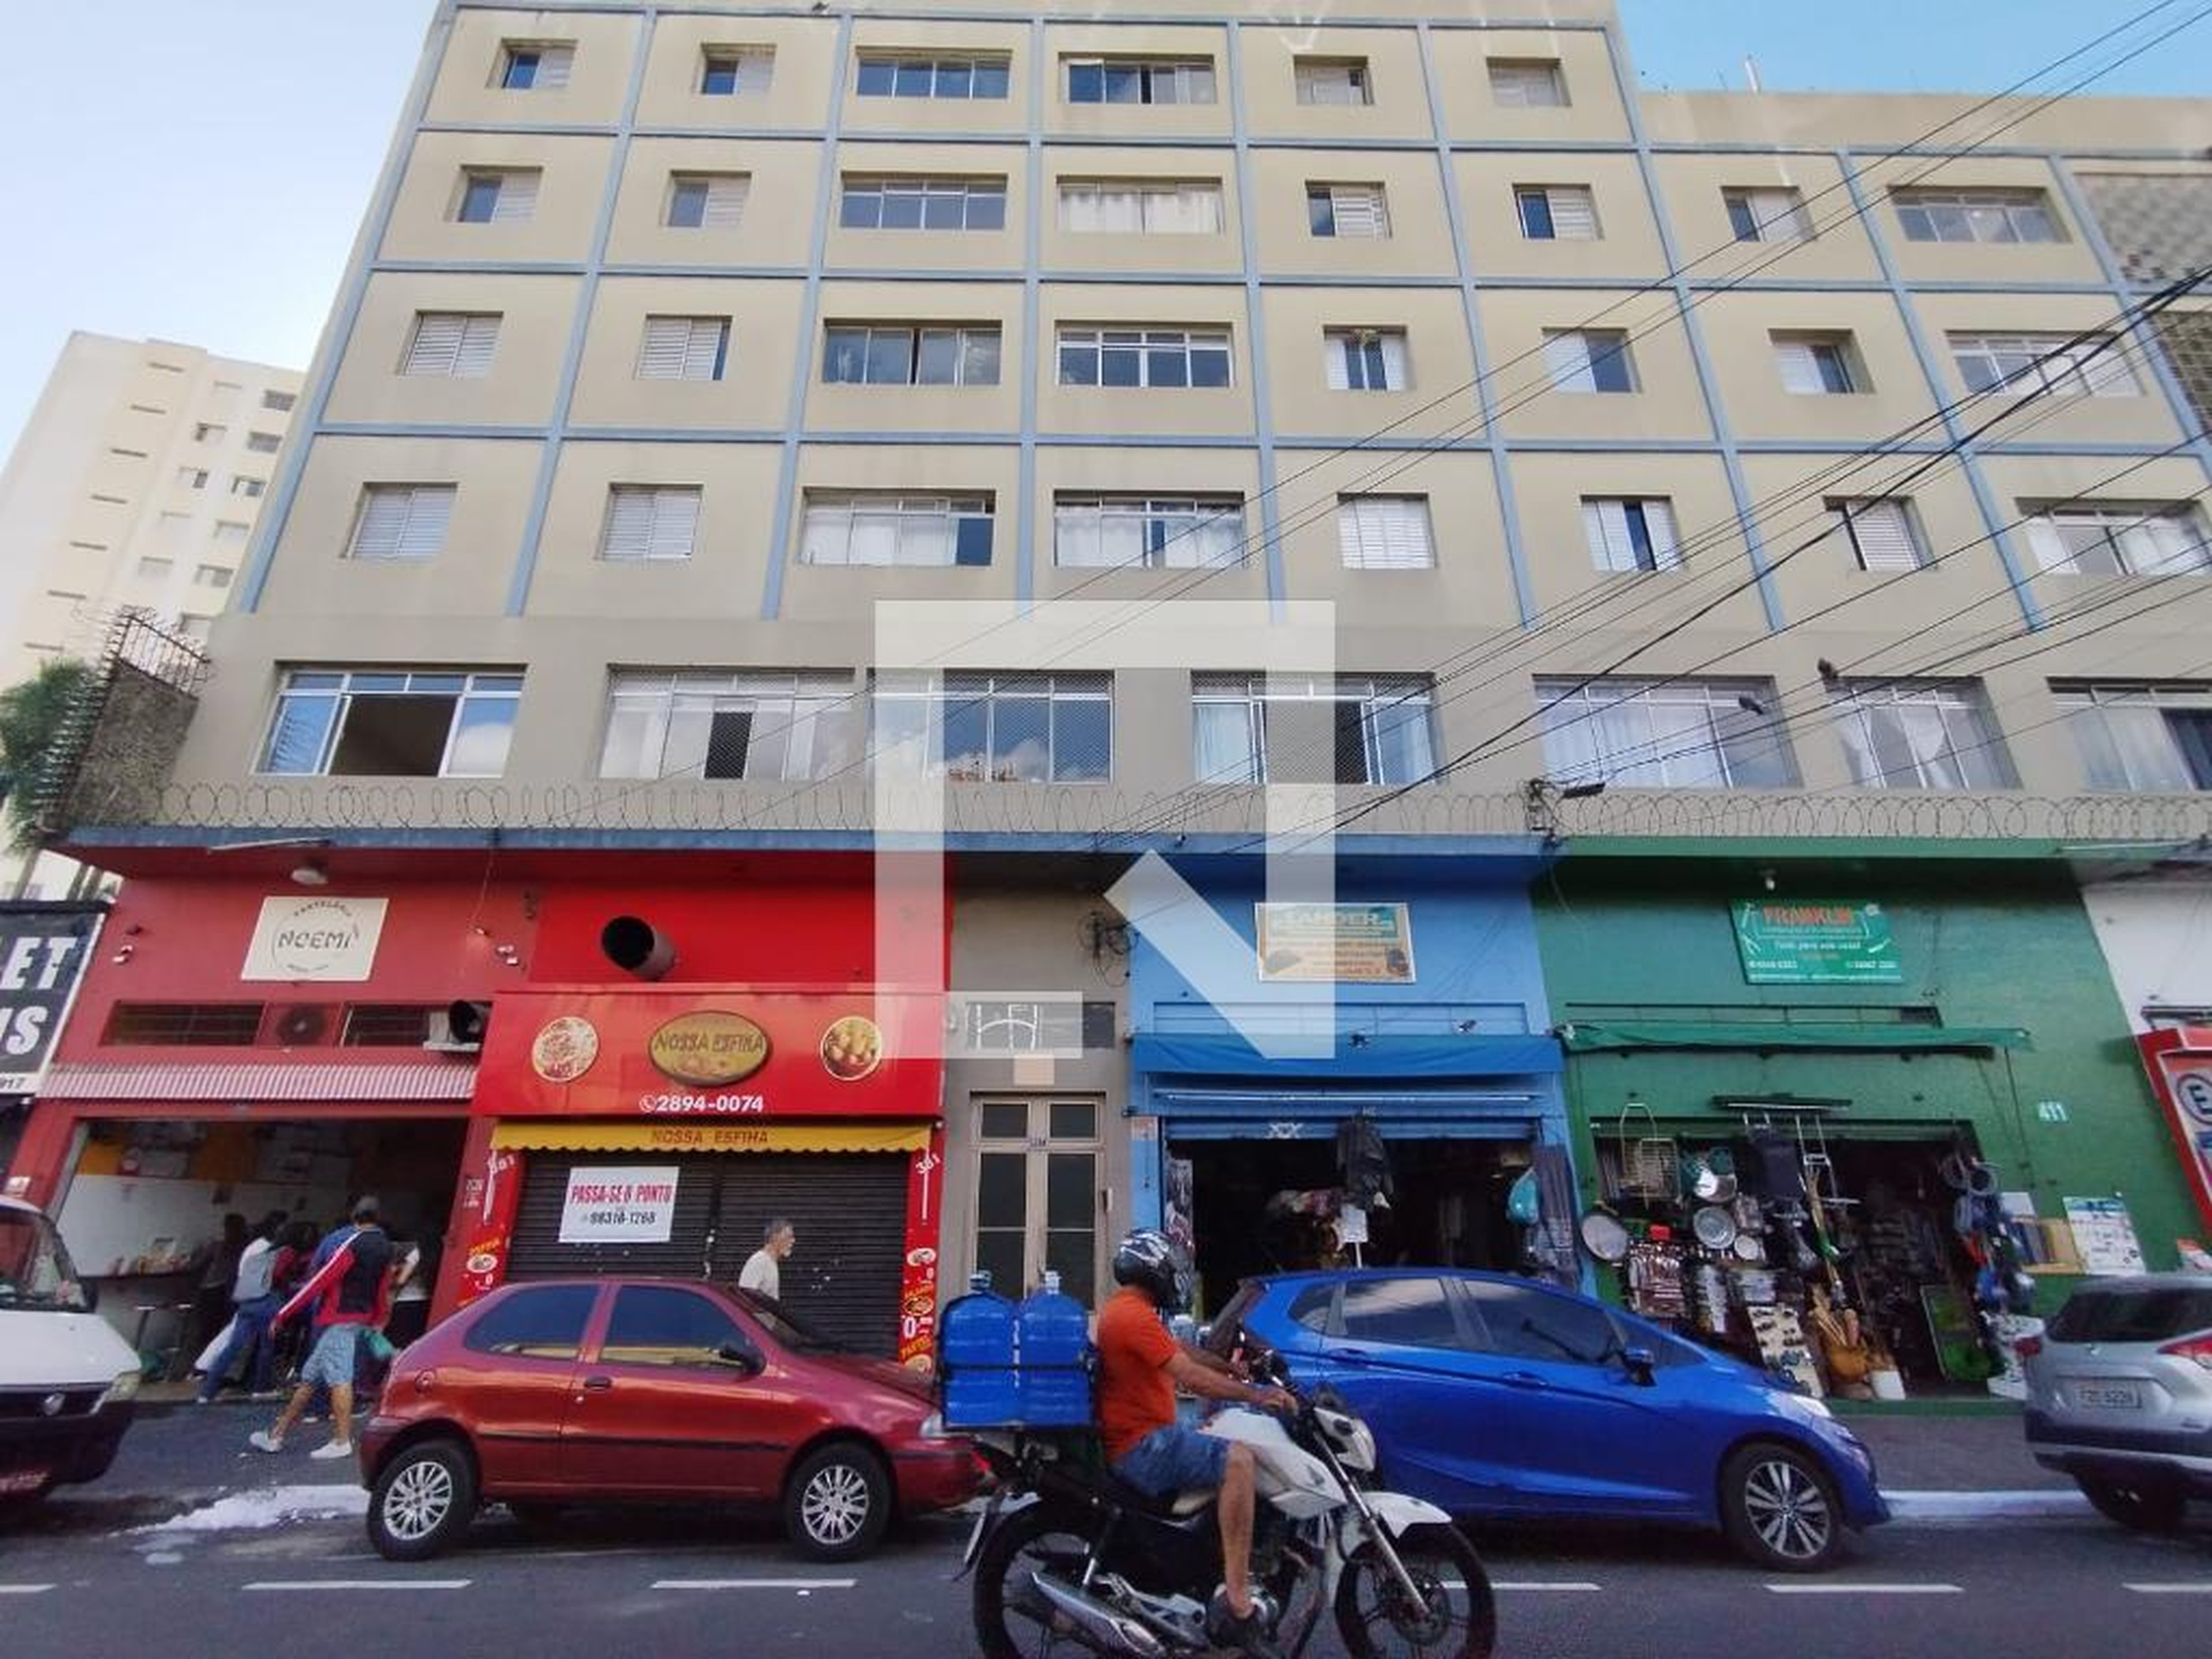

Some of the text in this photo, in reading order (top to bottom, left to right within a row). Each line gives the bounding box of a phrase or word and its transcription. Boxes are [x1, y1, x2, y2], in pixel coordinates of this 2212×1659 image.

[278, 930, 351, 949] NOEMI
[654, 1032, 709, 1052] NOSSA
[656, 1095, 764, 1112] 2894-0074
[652, 1129, 768, 1143] NOSSA ESFIHA
[636, 1184, 673, 1203] PONTO
